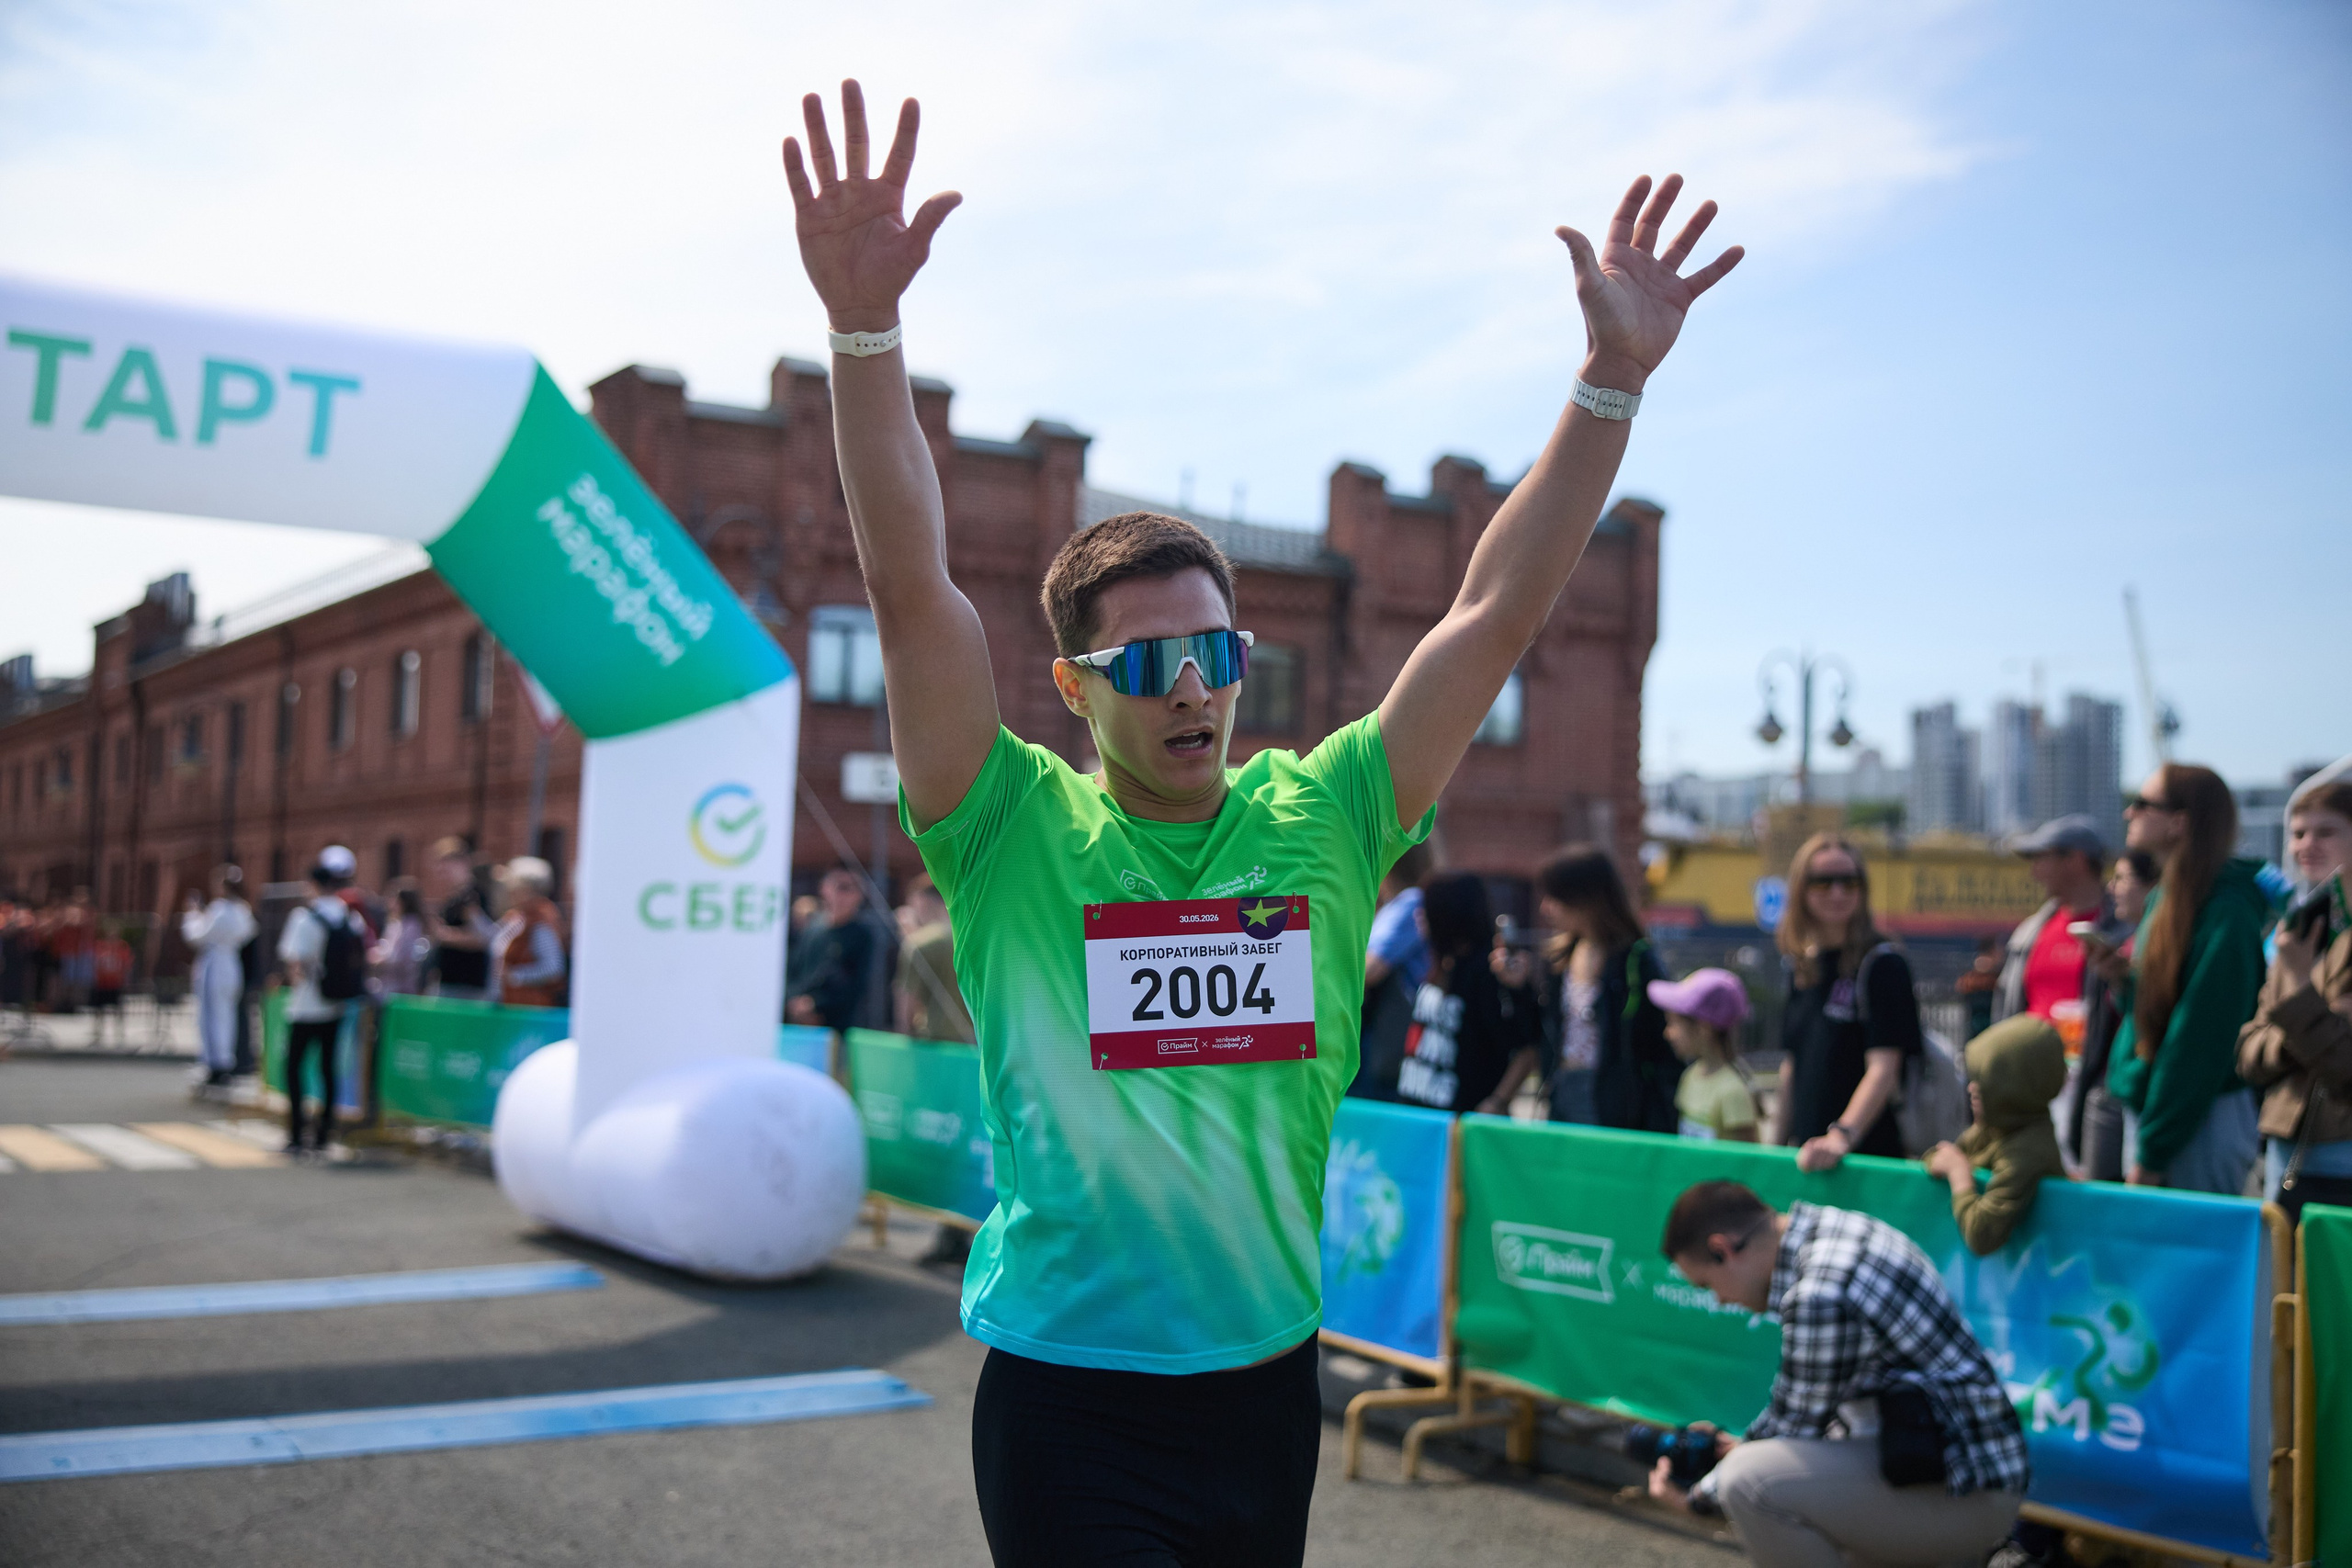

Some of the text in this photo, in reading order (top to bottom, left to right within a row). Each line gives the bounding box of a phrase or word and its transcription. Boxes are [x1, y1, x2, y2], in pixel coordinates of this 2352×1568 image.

[6, 328, 362, 458] ТАРТ
[537, 496, 685, 667] марафон
[1202, 875, 1245, 896] зелёный
[1179, 913, 1219, 923] 30.05.2026
[1120, 941, 1283, 961] КОРПОРАТИВНЫЙ ЗАБЕГ
[1130, 963, 1275, 1021] 2004
[1212, 1042, 1239, 1050] марафон
